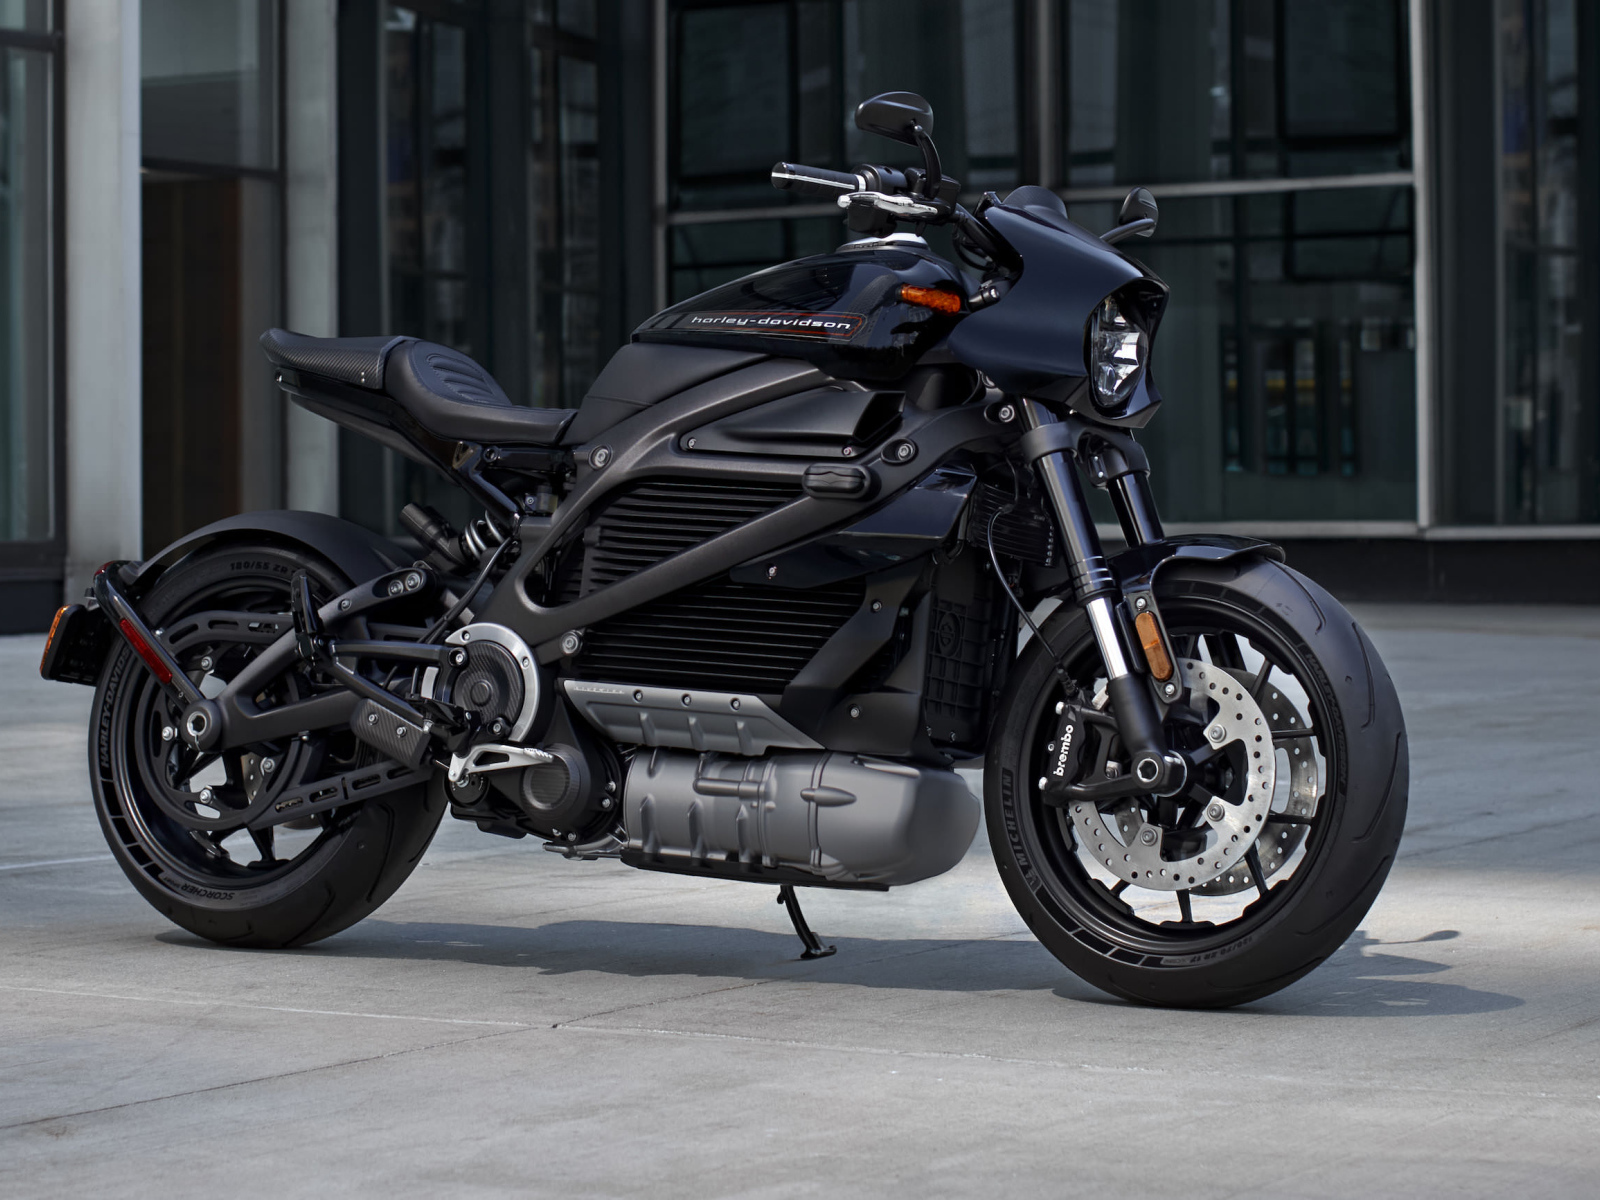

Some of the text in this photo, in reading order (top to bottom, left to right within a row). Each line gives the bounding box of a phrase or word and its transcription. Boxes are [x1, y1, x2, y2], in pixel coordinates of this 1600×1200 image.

[691, 316, 852, 330] harley-davidson
[230, 561, 270, 571] 180/55
[273, 564, 288, 574] ZR
[99, 645, 132, 769] HARLEY-DAVIDS
[1053, 724, 1074, 777] brembo
[1002, 771, 1029, 867] MICHELIN
[181, 883, 235, 901] SCORCHER
